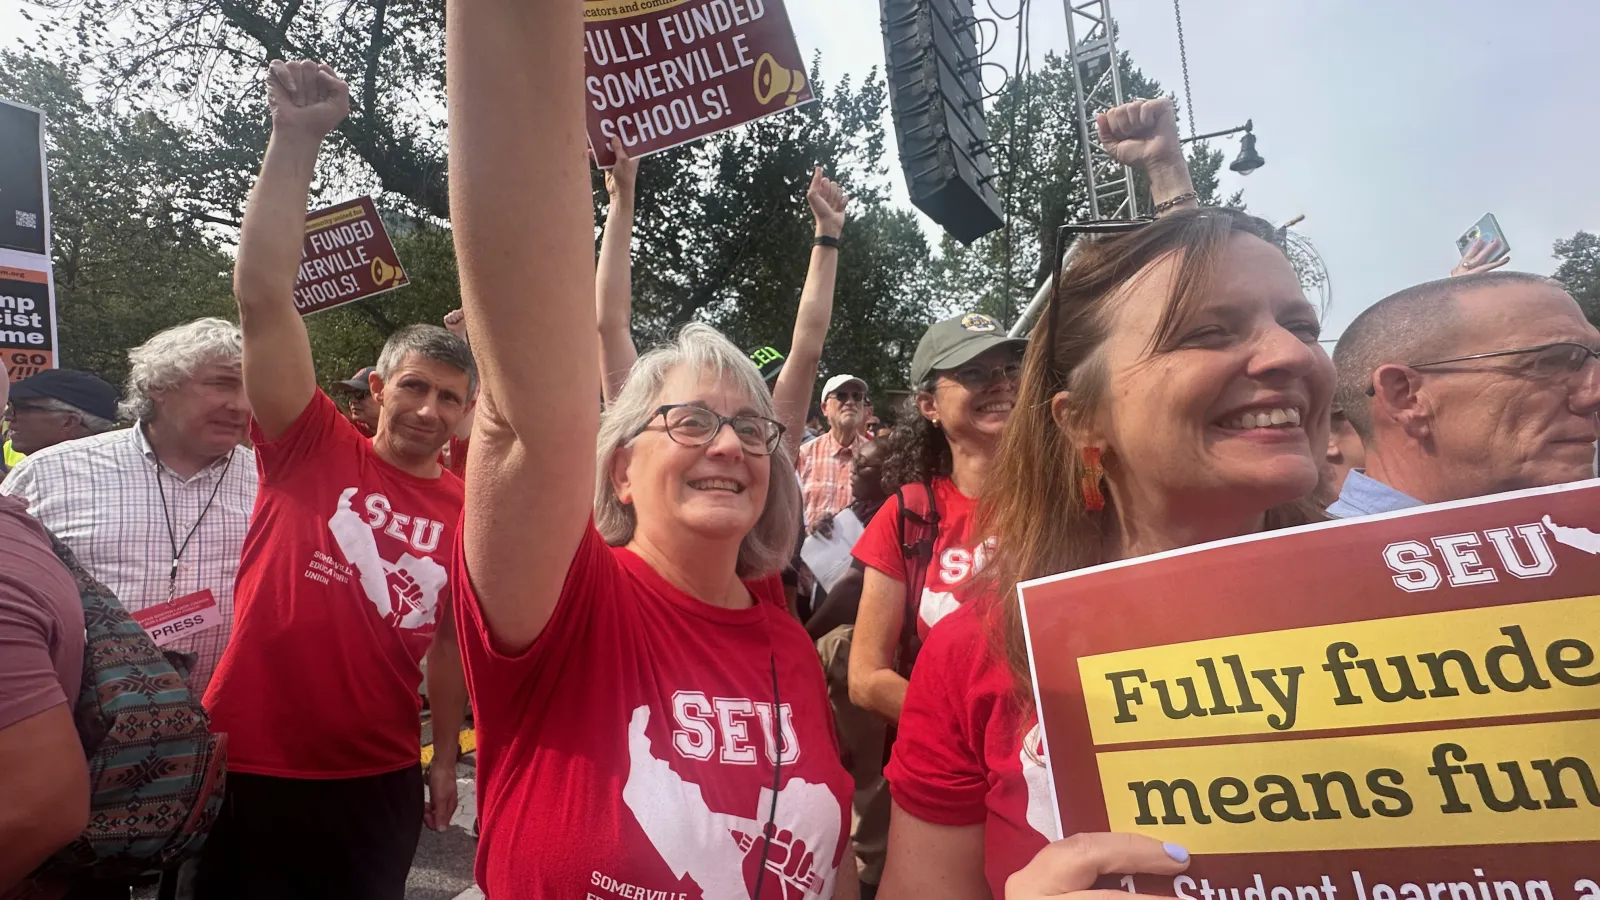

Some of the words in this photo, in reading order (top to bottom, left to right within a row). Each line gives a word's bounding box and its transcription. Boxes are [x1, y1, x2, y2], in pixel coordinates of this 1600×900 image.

[583, 7, 617, 17] cators
[620, 3, 639, 14] and
[584, 22, 651, 66] ULLY
[658, 0, 765, 50] FUNDED
[586, 33, 754, 111] SOMERVILLE
[600, 84, 732, 152] SCHOOLS!
[309, 219, 374, 254] FUNDED
[0, 309, 42, 329] ist
[0, 329, 44, 345] me
[11, 352, 46, 365] GO
[365, 492, 445, 553] SEU
[304, 570, 330, 586] UNION
[313, 550, 354, 577] SOMEVILLE
[1382, 521, 1558, 592] SEU
[151, 614, 205, 640] PRESS
[1105, 654, 1305, 731] Fully
[1322, 624, 1600, 706] funde
[671, 690, 801, 766] SEU
[1127, 767, 1414, 826] means
[1428, 742, 1600, 816] fun
